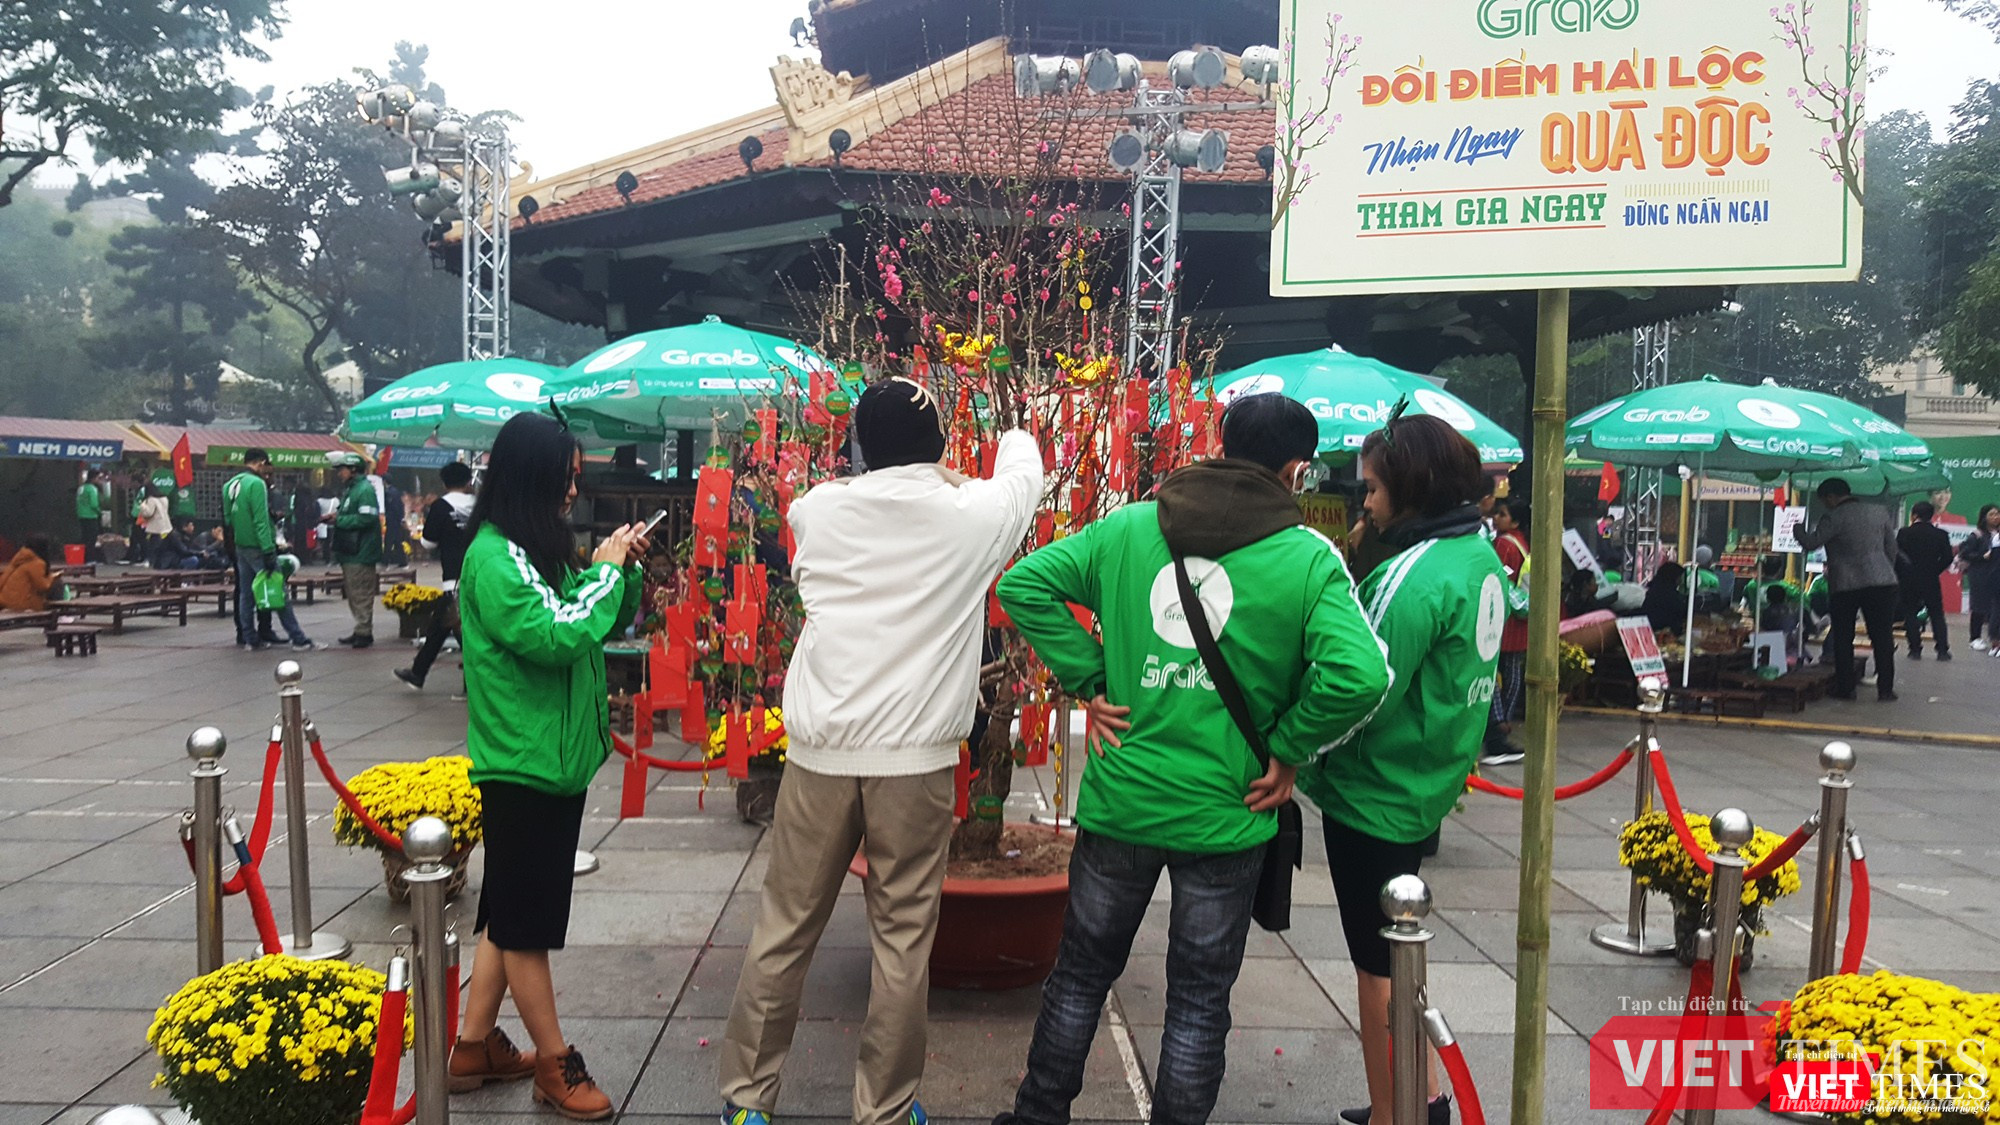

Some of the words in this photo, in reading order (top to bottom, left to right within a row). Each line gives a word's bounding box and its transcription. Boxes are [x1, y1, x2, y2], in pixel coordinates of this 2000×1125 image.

[1476, 0, 1640, 39] Grab
[1357, 54, 1437, 106] ĐỔI
[1444, 48, 1559, 100] ĐIỂM
[1668, 45, 1767, 92] LỘC
[1654, 95, 1772, 176] ĐỘC
[1362, 136, 1440, 176] Nhận
[1444, 125, 1525, 167] Ngay
[1357, 200, 1443, 231] THAM
[1455, 196, 1508, 226] GIA
[1521, 193, 1607, 224] NGAY
[1622, 199, 1669, 227] ĐỪNG
[1729, 200, 1769, 226] NGẠI
[660, 349, 759, 366] Grab
[381, 380, 452, 402] Grab
[567, 380, 600, 403] Grab
[1623, 405, 1710, 423] Grab
[1766, 436, 1809, 455] Grab
[1961, 459, 1991, 469] GRAB
